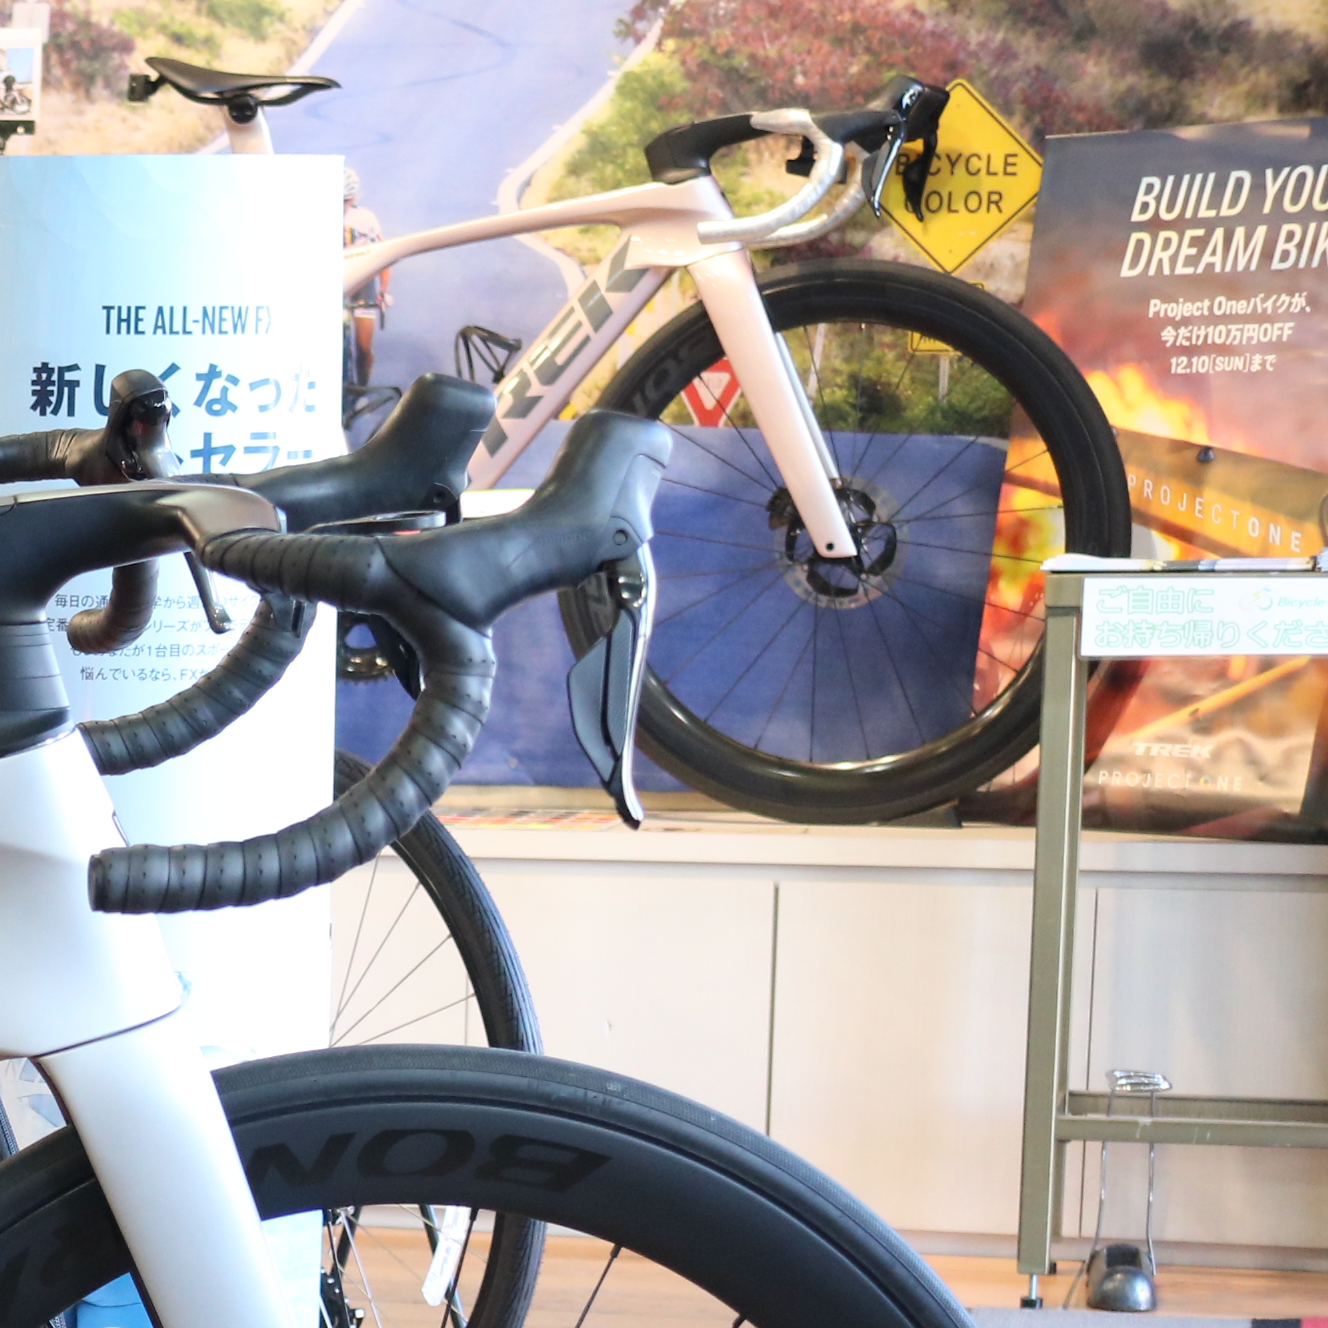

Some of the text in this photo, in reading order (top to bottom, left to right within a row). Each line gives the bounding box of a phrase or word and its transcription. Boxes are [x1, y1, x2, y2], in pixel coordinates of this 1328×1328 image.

[895, 153, 1018, 176] BCYCLE
[906, 190, 1004, 214] OLOR
[1130, 169, 1252, 222] BUILD
[1120, 225, 1268, 277] DREAM
[101, 305, 147, 336] THE
[152, 305, 249, 336] ALL-NEW
[1148, 297, 1210, 321] Project
[1160, 322, 1295, 347] 今だけ10万円OFF
[1170, 353, 1277, 374] 12.10[SUN]まで
[1096, 585, 1215, 615] ご自由に
[1132, 742, 1213, 759] TREK
